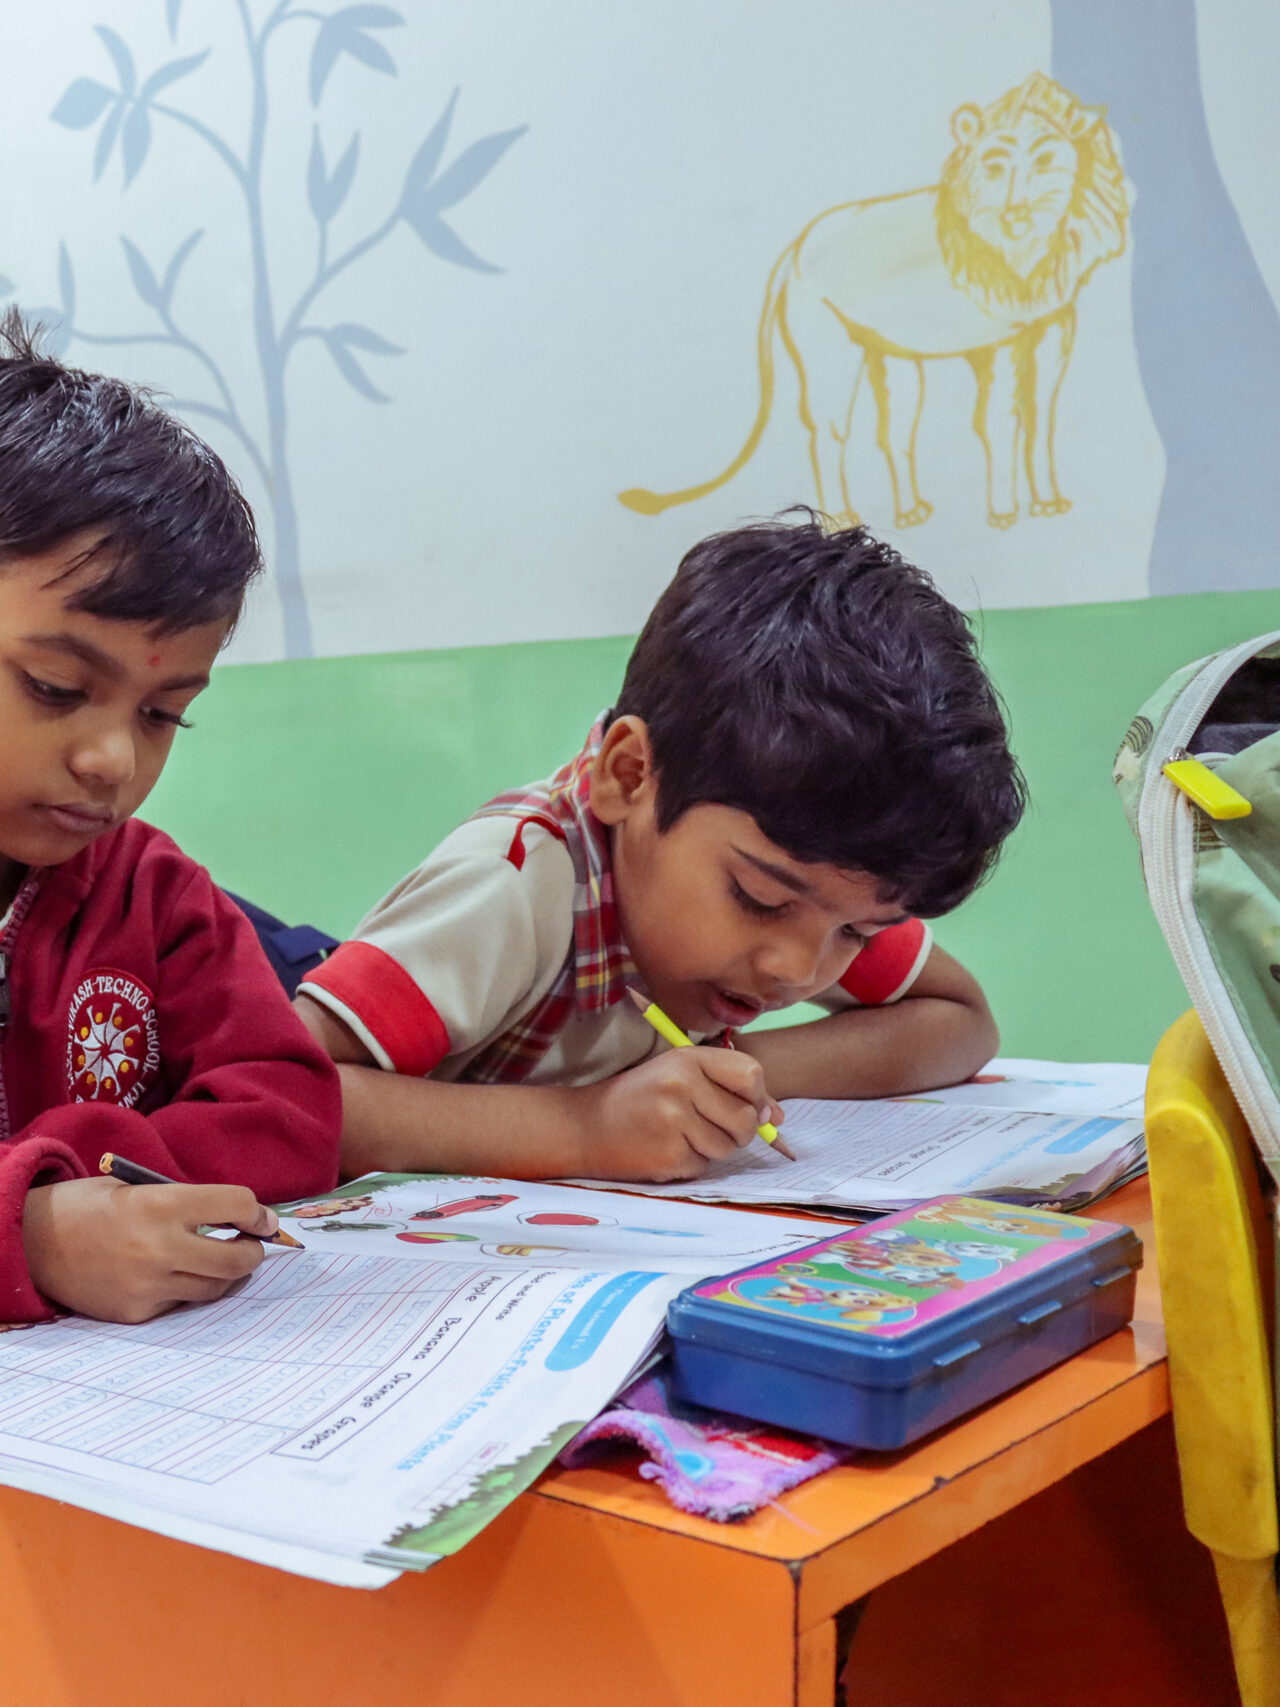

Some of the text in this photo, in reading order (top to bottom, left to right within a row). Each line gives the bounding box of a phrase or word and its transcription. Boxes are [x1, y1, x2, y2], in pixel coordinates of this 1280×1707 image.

[96, 976, 149, 1011] TECHNO
[142, 1009, 160, 1073] SCHOOL
[465, 1275, 502, 1302] Apple
[557, 1291, 577, 1304] of
[495, 1297, 523, 1321] Write
[412, 1316, 462, 1361] Banana
[360, 1372, 412, 1408] Orange
[442, 1400, 489, 1431] from
[301, 1416, 357, 1450] Grapes
[397, 1433, 455, 1470] Plants
